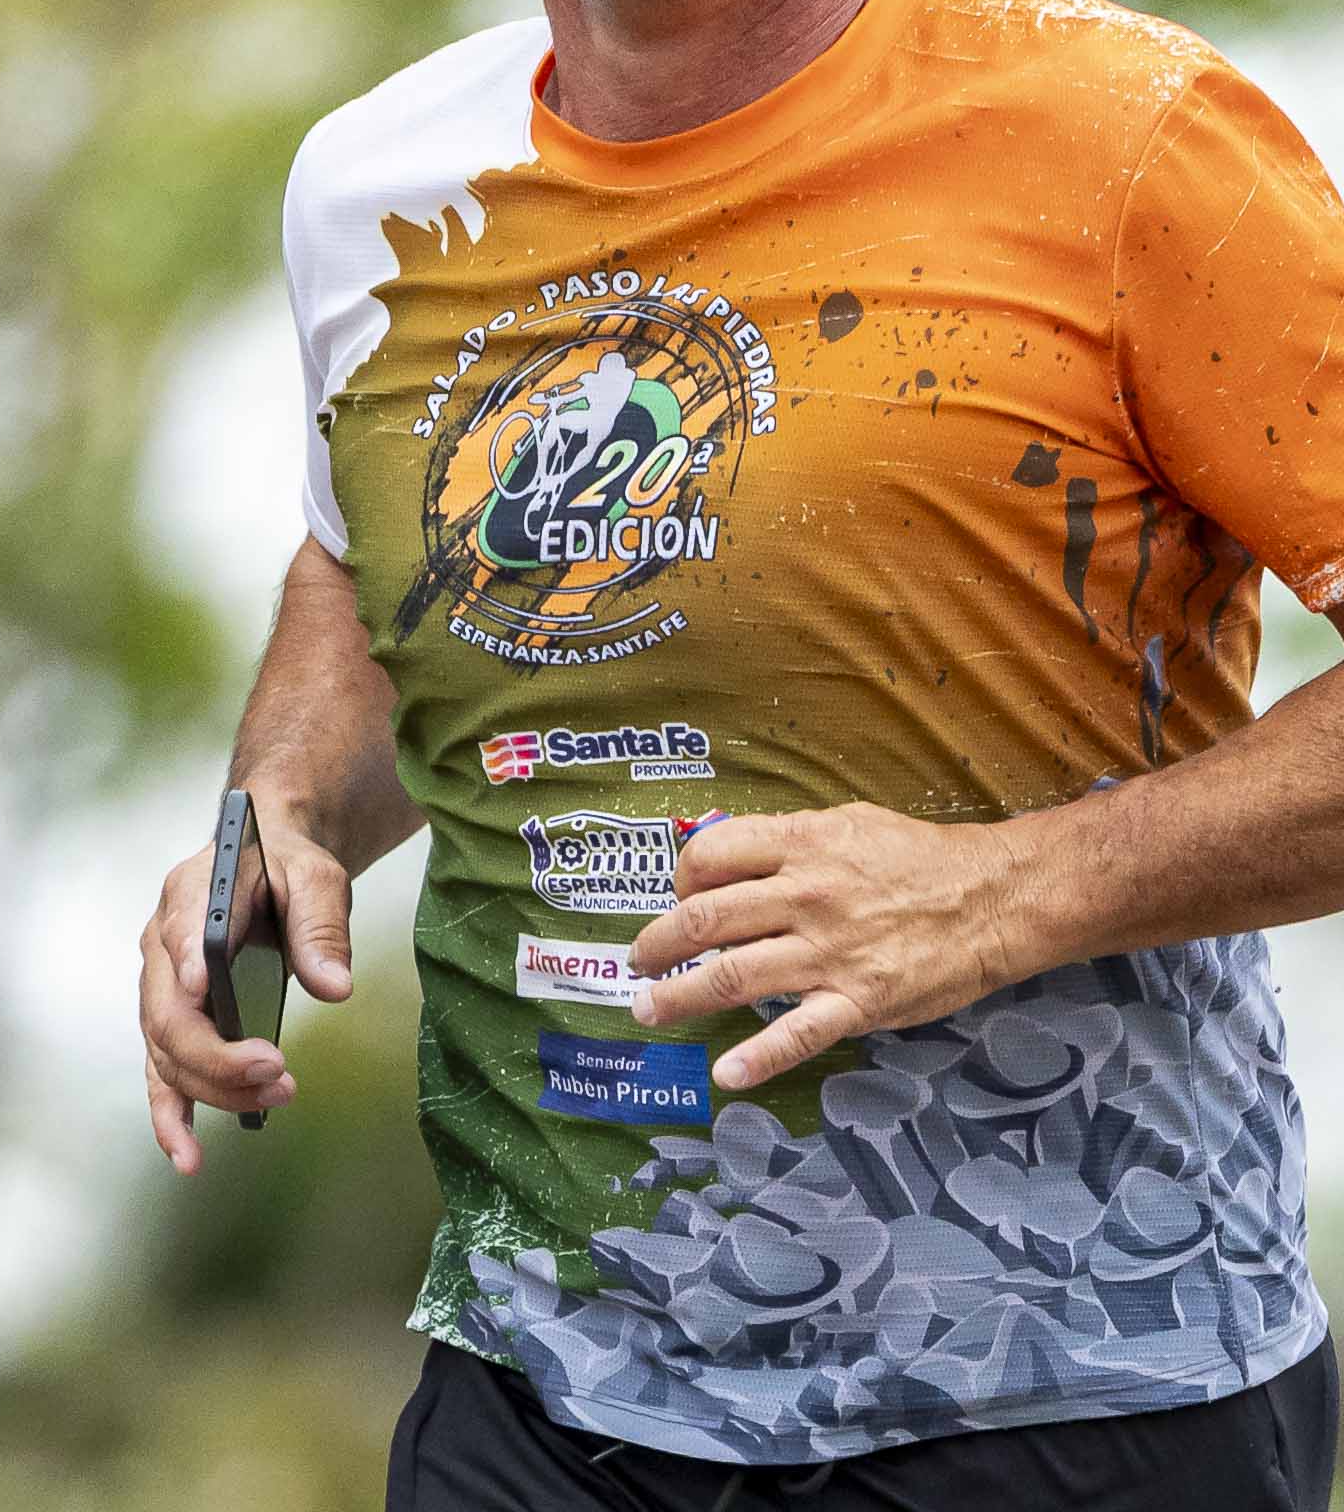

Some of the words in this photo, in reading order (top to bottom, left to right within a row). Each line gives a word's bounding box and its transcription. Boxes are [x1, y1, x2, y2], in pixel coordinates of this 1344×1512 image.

[411, 310, 517, 439] SALADO
[537, 269, 642, 309] PASO
[645, 275, 708, 306] LAS
[704, 295, 778, 437] PIEDRAS
[658, 609, 689, 637] FE
[634, 763, 712, 778] PROVINCIA
[547, 877, 675, 895] ESPERANZA
[525, 944, 619, 980] Jimena
[576, 1051, 646, 1072] Senador
[549, 1069, 609, 1101] Rubén
[616, 1081, 698, 1107] Pirola
